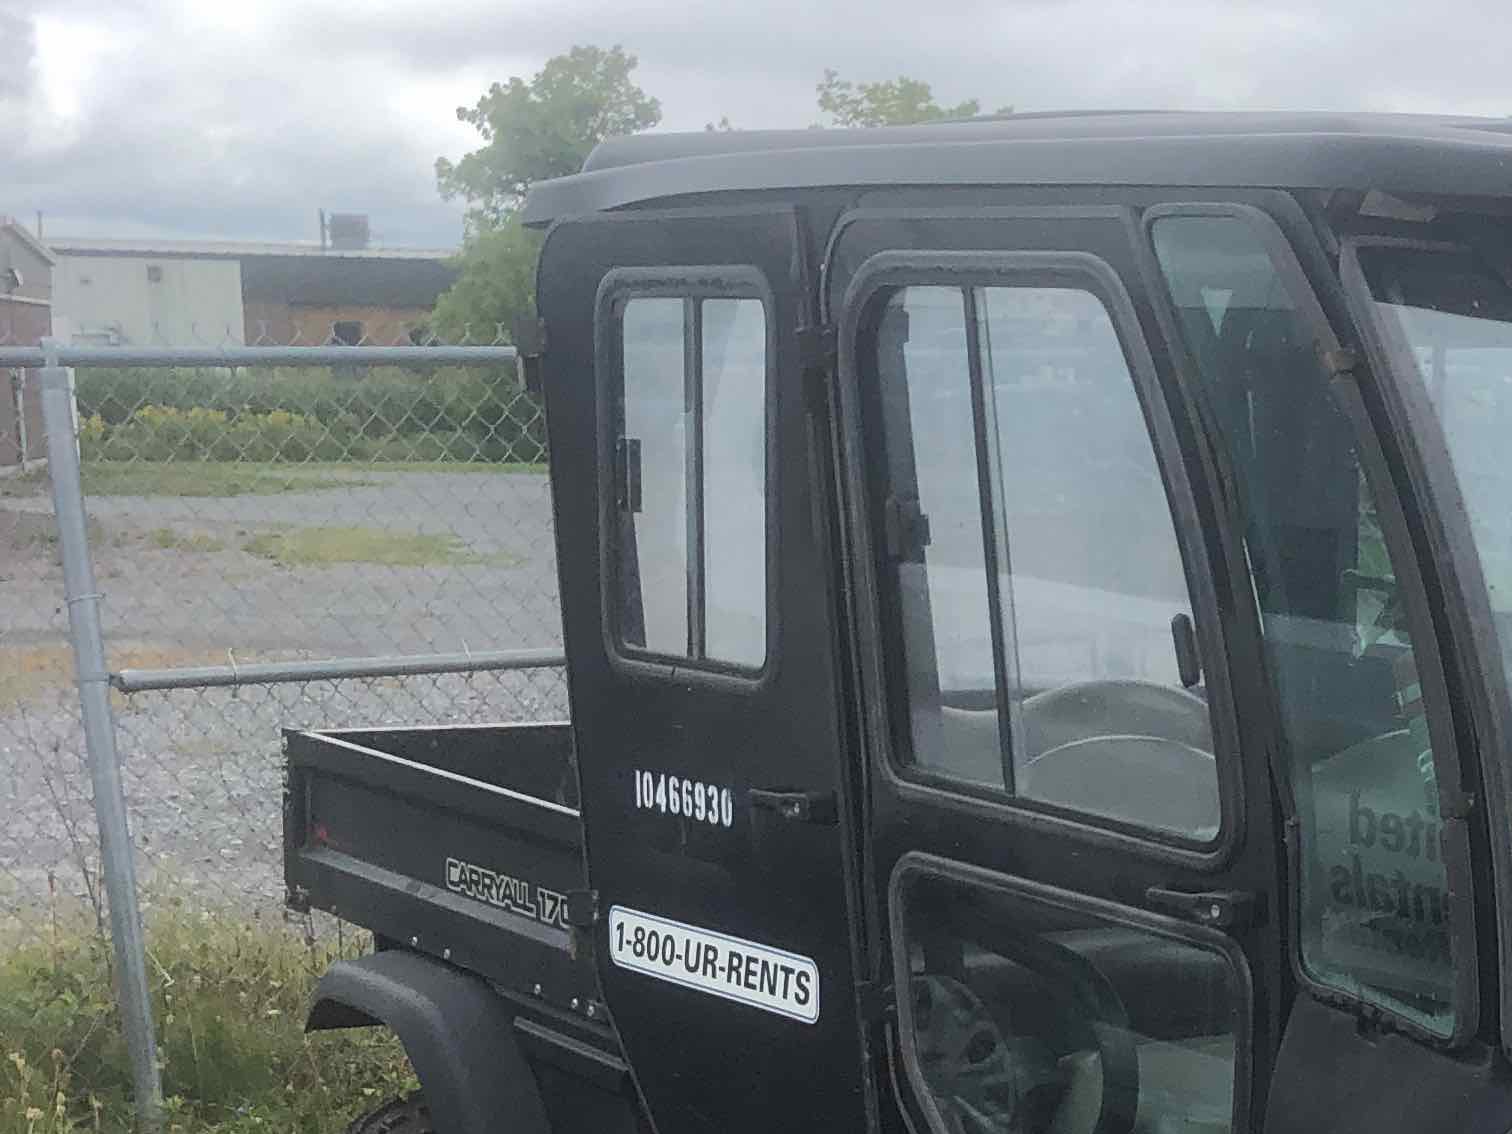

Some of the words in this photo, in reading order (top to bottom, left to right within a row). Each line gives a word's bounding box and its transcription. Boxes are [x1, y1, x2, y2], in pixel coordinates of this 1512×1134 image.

[635, 769, 733, 827] 10466930
[445, 857, 537, 918] CARRYALL
[615, 921, 812, 1006] 1-800-UR-RENTS
